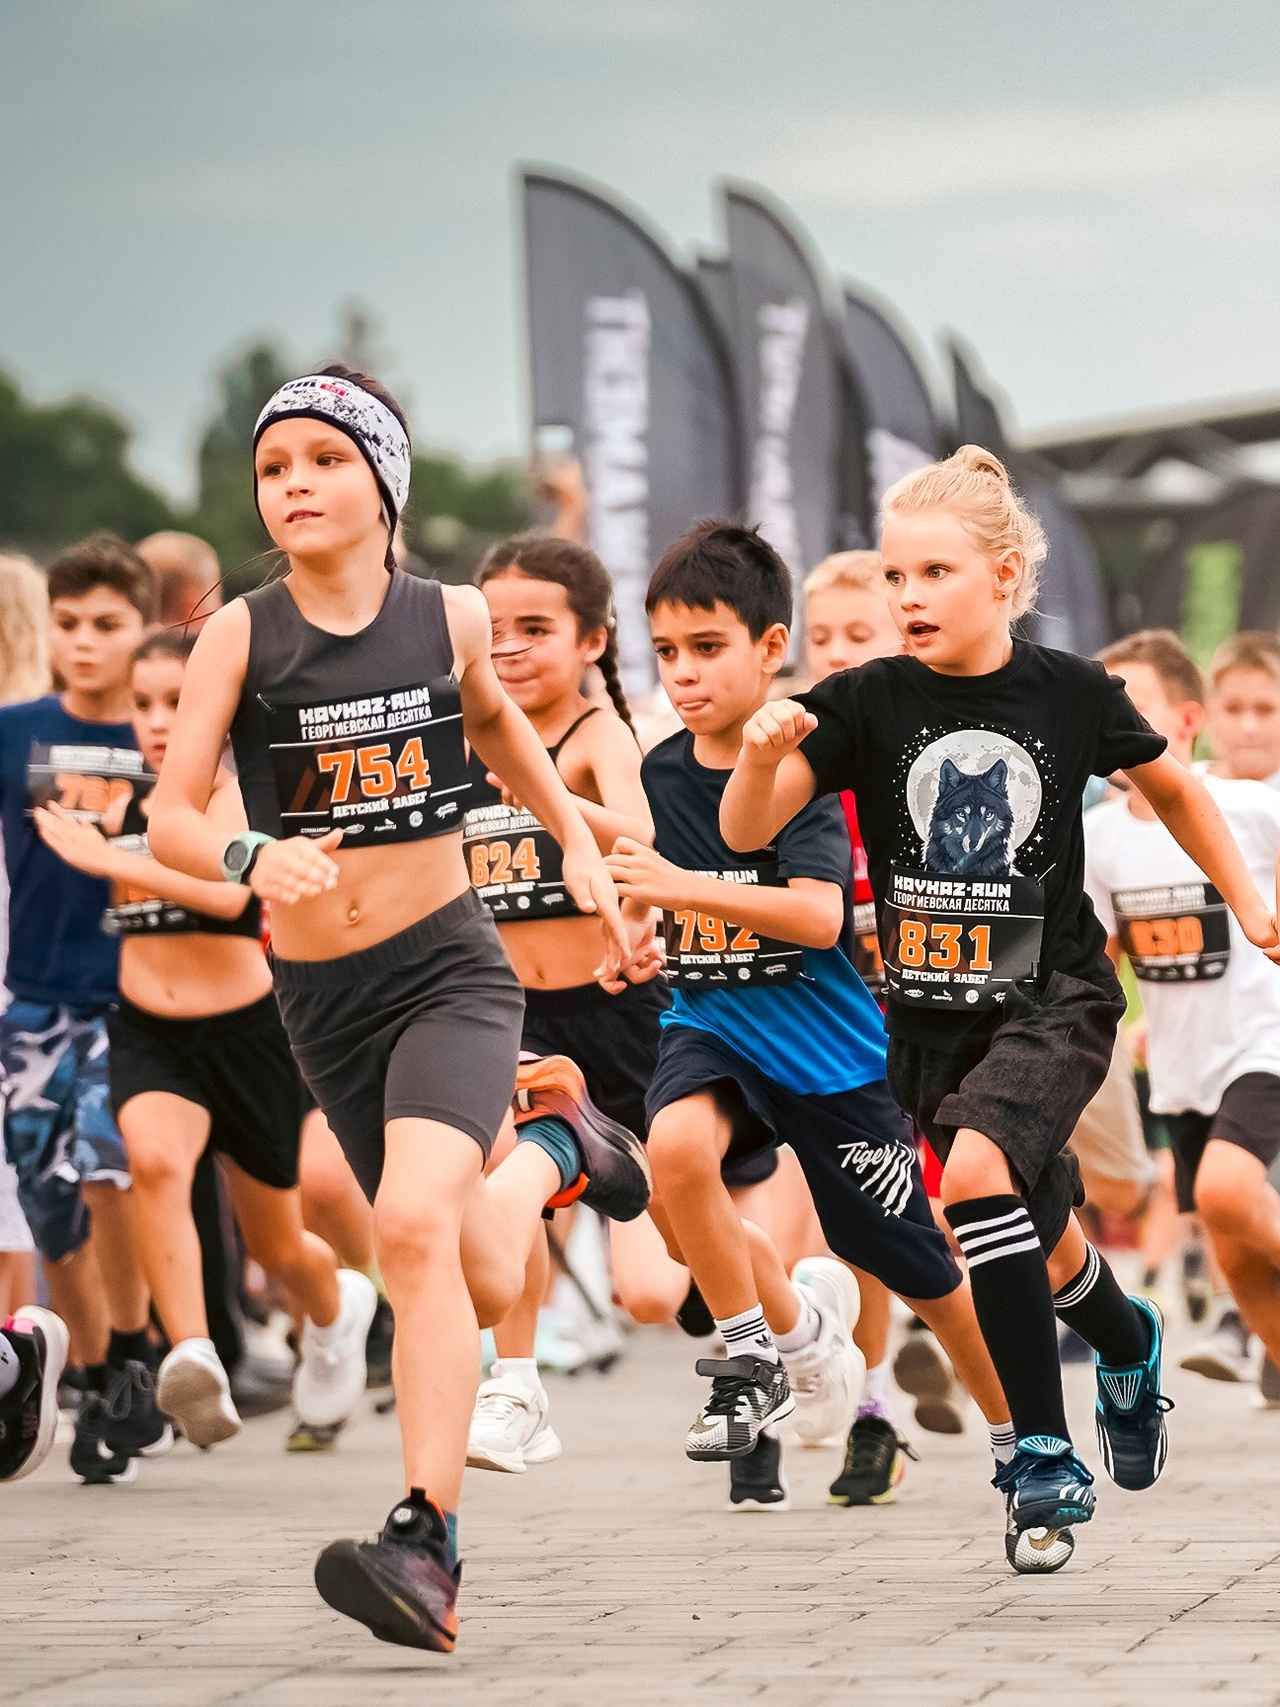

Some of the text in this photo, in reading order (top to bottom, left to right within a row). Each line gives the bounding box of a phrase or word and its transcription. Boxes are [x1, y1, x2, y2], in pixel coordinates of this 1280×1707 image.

[301, 704, 433, 740] ГЕОРГИЕВСКАЯ ДЕСЯТКА
[317, 736, 432, 804] 754
[332, 791, 428, 819] ДЕТСКИЙ ЗАБЕГ
[471, 837, 541, 887] 824
[893, 890, 1010, 912] ГЕОРГИЕВСКАЯ ДЕСЯТКА
[674, 909, 760, 952] 792
[898, 919, 993, 972] 831
[724, 952, 755, 964] ЗАБЕГ
[901, 968, 989, 985] ДЕТСКИЙ ЗАБЕГ
[837, 1141, 890, 1175] Tiger
